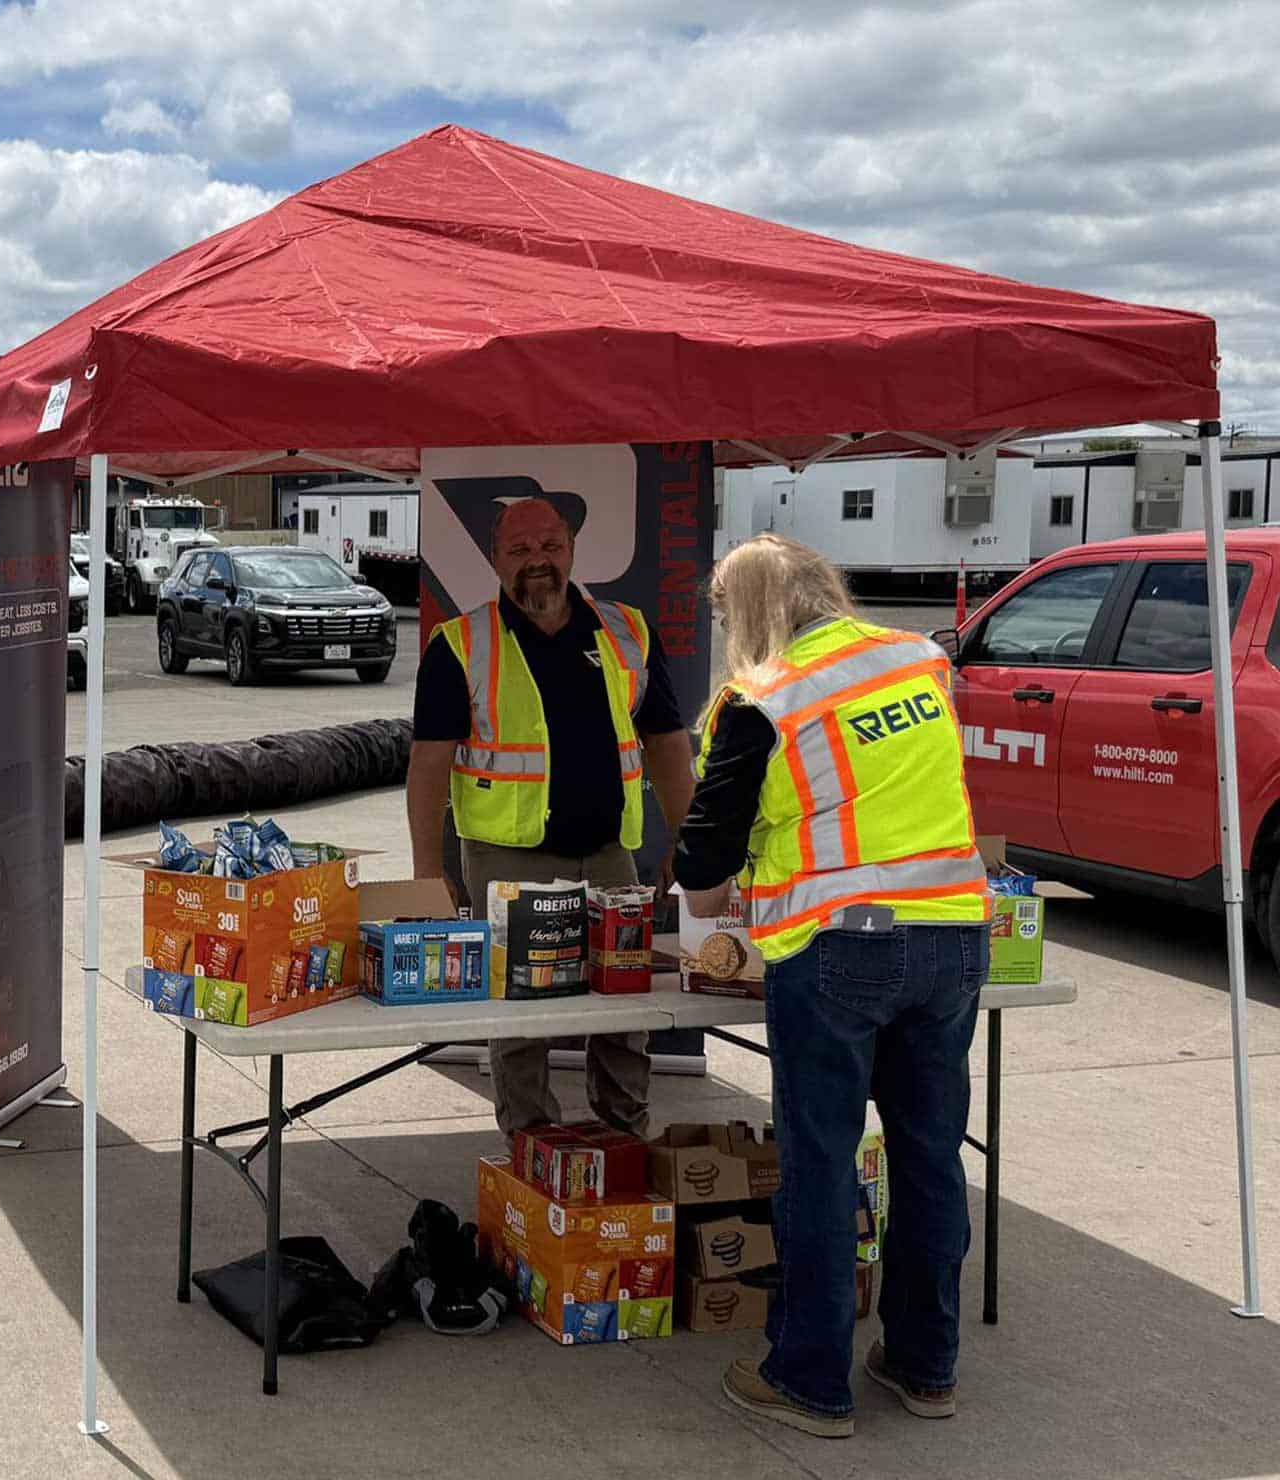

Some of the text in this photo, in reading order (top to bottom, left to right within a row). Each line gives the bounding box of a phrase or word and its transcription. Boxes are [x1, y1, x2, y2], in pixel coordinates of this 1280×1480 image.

[658, 439, 702, 657] RENTALS
[16, 604, 31, 618] LESS
[32, 602, 57, 615] COSTS.
[847, 692, 940, 746] REIC
[960, 725, 1046, 767] ILTI
[1094, 743, 1178, 765] 1-800-879-8000
[1093, 764, 1174, 784] www.hilti.com
[176, 888, 200, 905] Sun
[533, 897, 581, 912] OBERTO
[293, 896, 319, 923] Sun
[218, 912, 233, 931] 30
[393, 954, 419, 970] NUTS
[504, 1201, 525, 1226] Sun
[600, 1220, 626, 1238] Sun
[644, 1235, 659, 1252] 30
